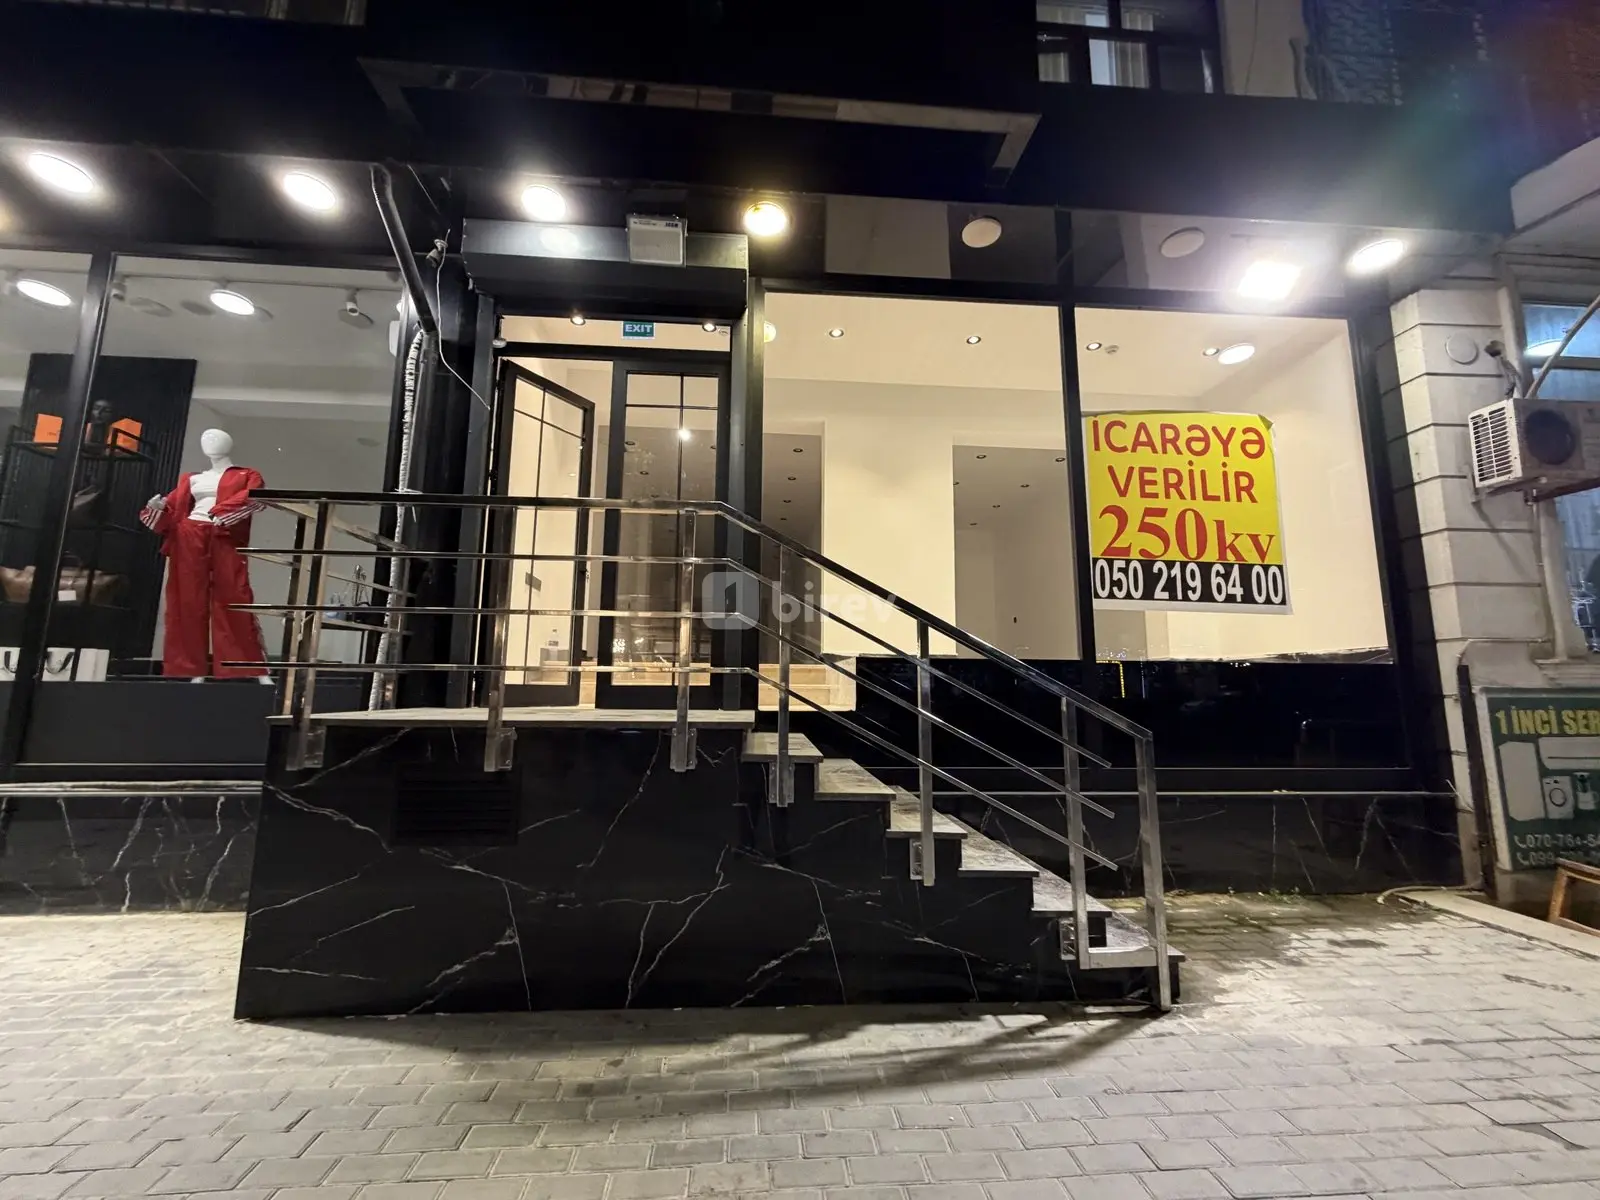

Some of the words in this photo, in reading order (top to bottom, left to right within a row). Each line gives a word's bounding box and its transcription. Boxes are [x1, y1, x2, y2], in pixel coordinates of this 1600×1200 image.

[1107, 460, 1258, 503] VERİLİR
[1099, 505, 1208, 560] 250
[1095, 559, 1143, 599] 050
[1152, 562, 1201, 601] 219
[1211, 563, 1243, 602] 64
[1251, 565, 1283, 604] 00
[1495, 709, 1509, 734] 1
[1510, 705, 1559, 734] İNCİ
